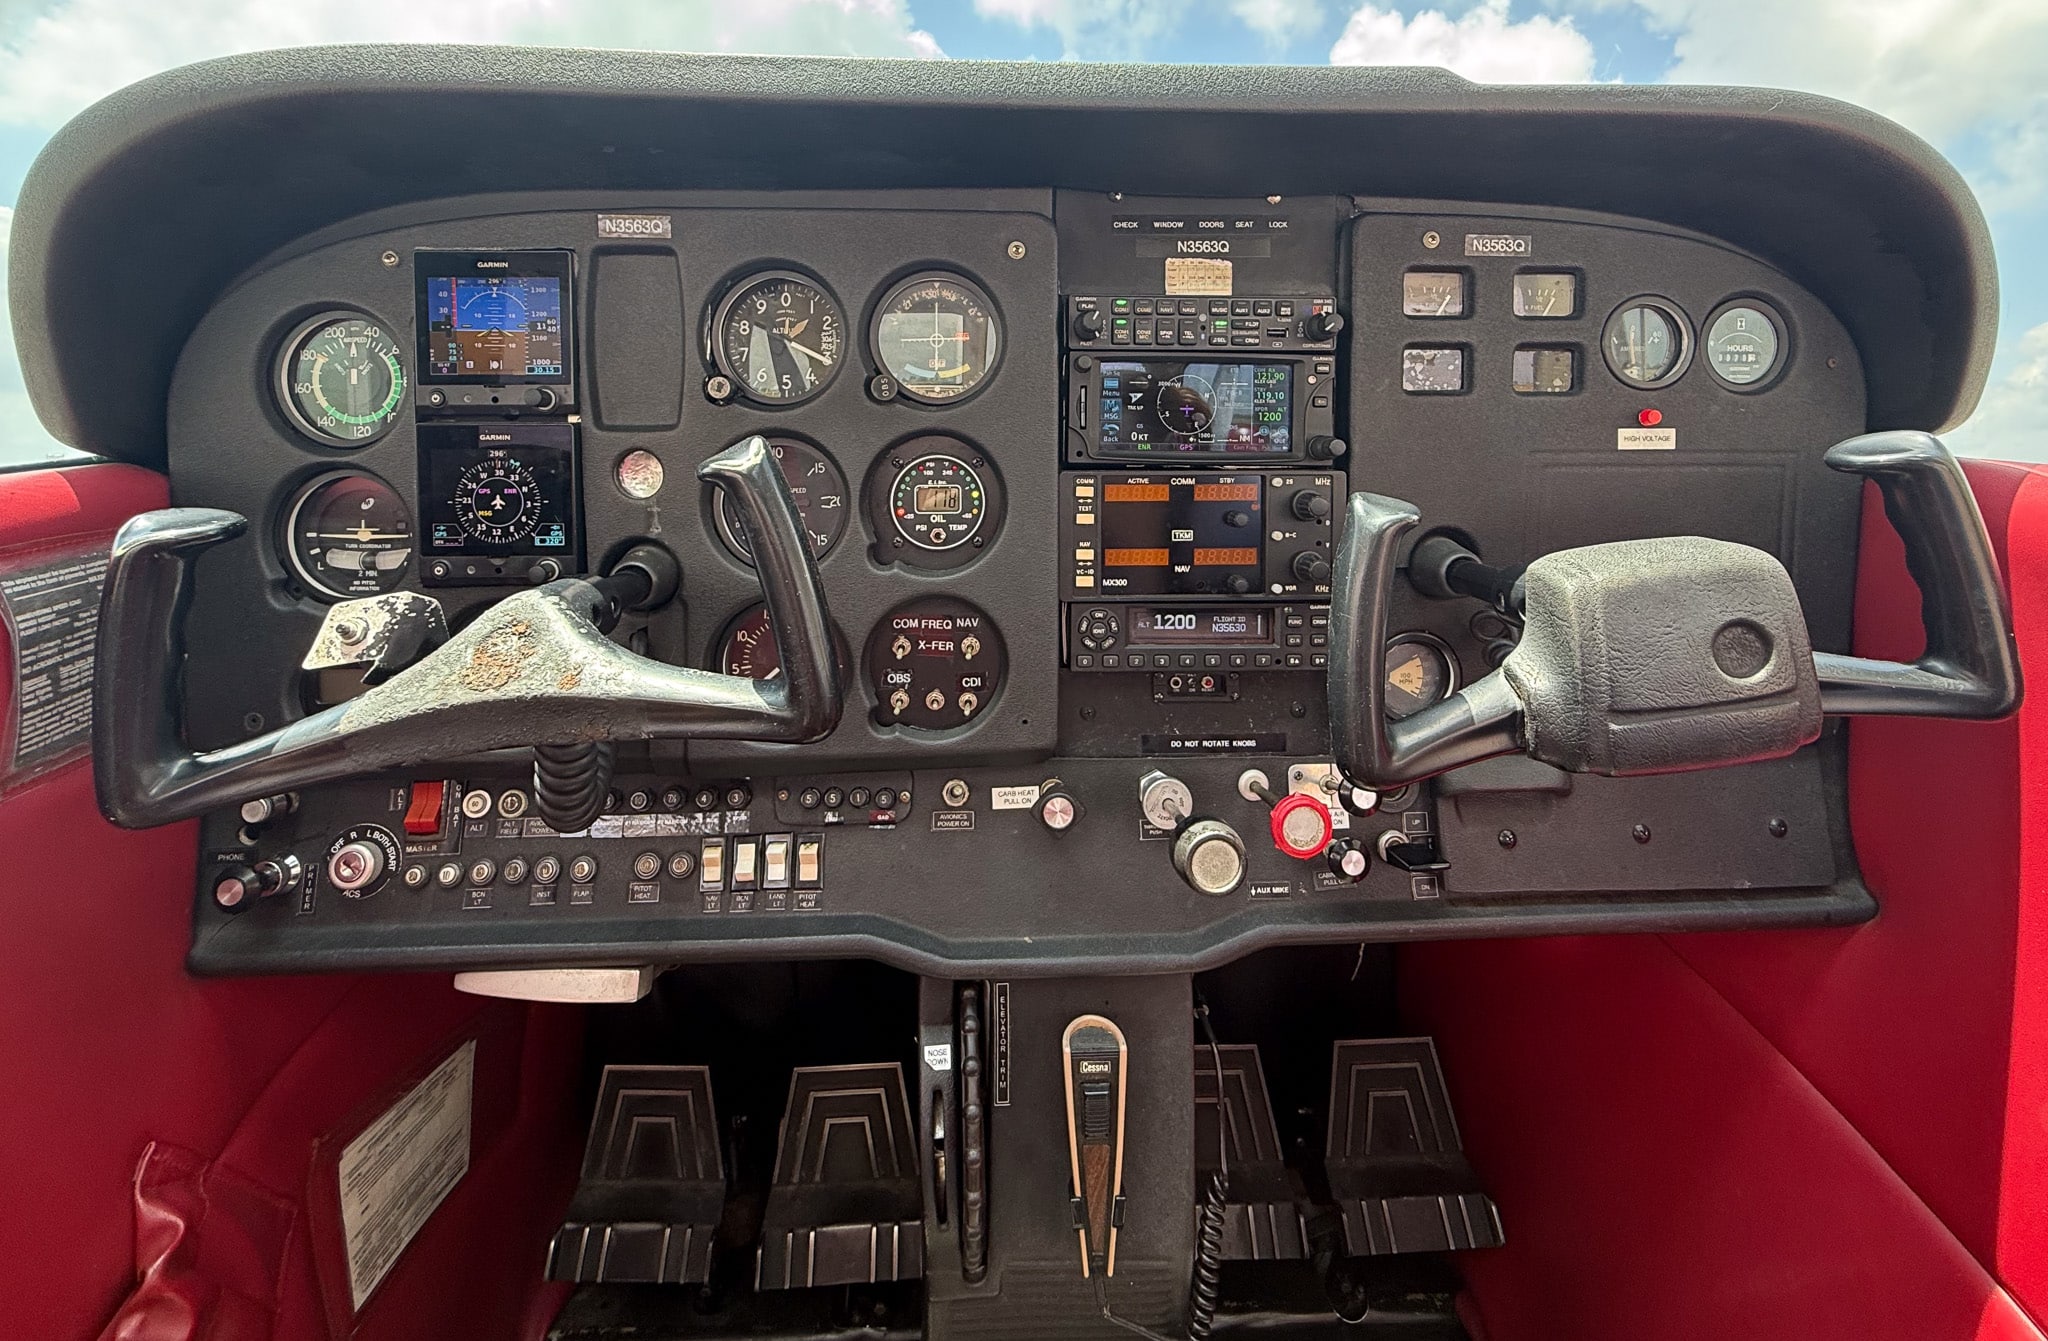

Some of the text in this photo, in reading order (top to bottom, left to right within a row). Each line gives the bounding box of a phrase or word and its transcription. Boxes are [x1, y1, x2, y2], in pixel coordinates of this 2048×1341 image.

[605, 219, 662, 234] N3563Q
[1113, 221, 1288, 229] CHECK WINDOW DOORS SEAT LOCK
[1177, 240, 1230, 253] N3563Q
[1472, 239, 1525, 252] N3563Q
[781, 292, 791, 307] 0
[756, 299, 767, 314] 9
[810, 299, 813, 314] 1
[739, 320, 749, 335] 8
[822, 315, 831, 330] 2
[324, 327, 345, 338] 200
[363, 327, 379, 337] 40
[1727, 344, 1754, 352] HOURS
[300, 349, 316, 360] 180
[740, 347, 749, 362] 7
[757, 367, 767, 382] 6
[805, 367, 816, 382] 4
[781, 375, 792, 389] 5
[294, 383, 311, 394] 160
[317, 416, 335, 427] 140
[1258, 412, 1281, 421] 1200
[353, 426, 371, 437] 120
[1131, 432, 1149, 441] 0 KT
[815, 463, 825, 473] 15
[1315, 477, 1331, 486] MHz
[930, 515, 946, 523] OIL
[817, 534, 828, 546] 15
[1175, 531, 1191, 540] TKM
[317, 561, 324, 570] L
[1174, 565, 1191, 573] NAV
[893, 618, 952, 629] COM FREQ
[956, 617, 979, 628] NAV
[1153, 614, 1196, 630] 1200
[737, 630, 748, 642] 10
[918, 640, 954, 651] X-FER
[732, 663, 740, 674] 5
[887, 673, 911, 684] OBS
[962, 677, 981, 687] CDI
[701, 794, 707, 803] 4
[806, 794, 812, 803] 5
[829, 793, 836, 803] 5
[856, 793, 860, 803] 1
[881, 795, 887, 804] 5
[452, 784, 462, 828] ON BAT
[469, 824, 484, 832] ALT
[330, 829, 396, 872] OFF R L BOTH START
[217, 853, 245, 861] PHONE
[303, 865, 314, 910] PRIMER
[1323, 878, 1338, 886] PULL
[342, 889, 361, 898] ACS
[1272, 886, 1289, 894] MIKE
[634, 892, 651, 900] HEAT
[927, 1049, 948, 1057] NOSE
[1082, 1062, 1109, 1073] Cessna
